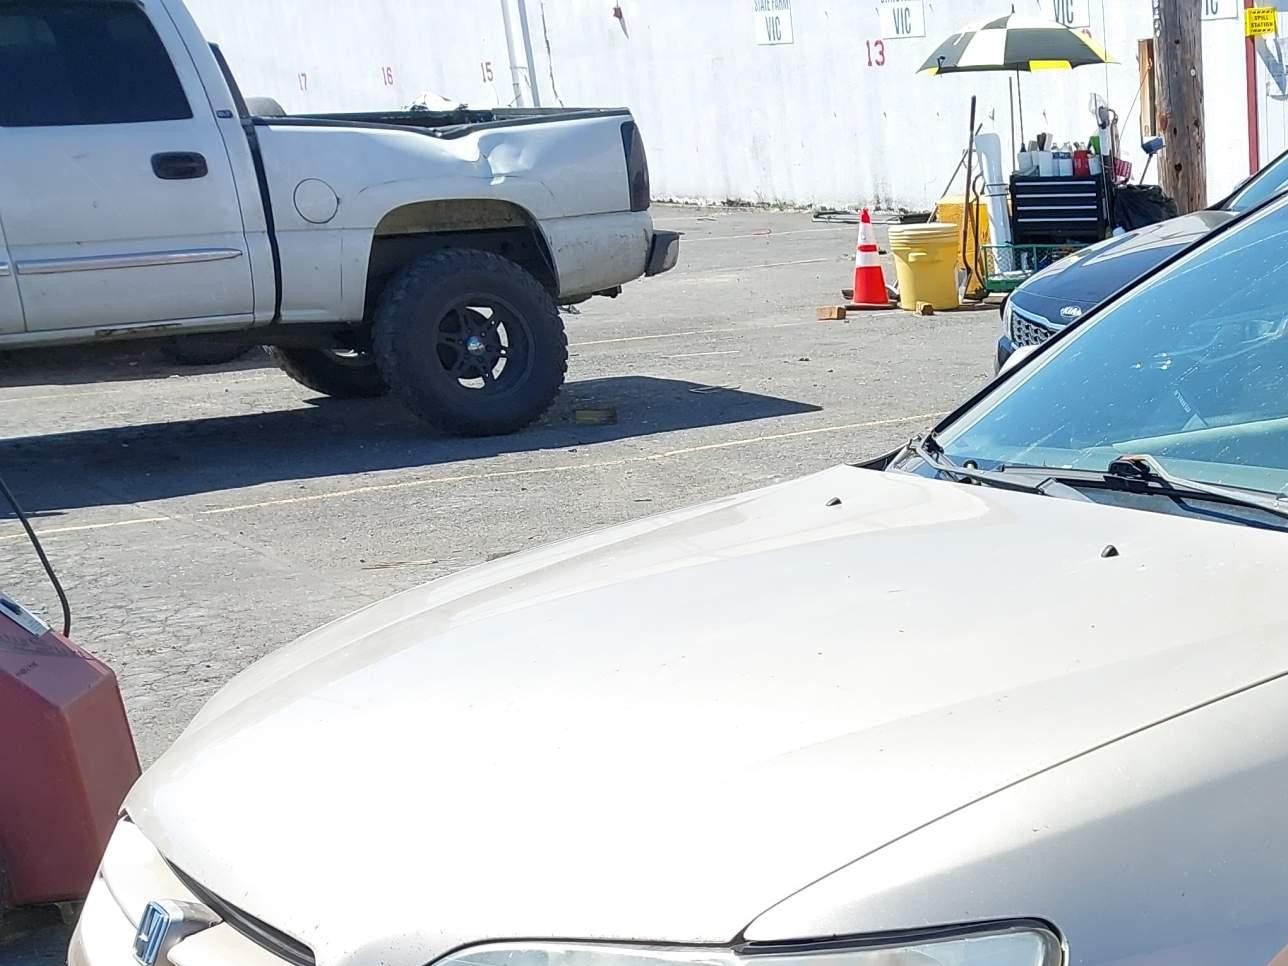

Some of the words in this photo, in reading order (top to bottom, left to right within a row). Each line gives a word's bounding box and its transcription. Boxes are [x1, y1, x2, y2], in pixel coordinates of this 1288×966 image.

[765, 16, 782, 41] VIC
[892, 7, 911, 35] VIC
[866, 40, 886, 66] 13
[298, 73, 308, 90] 17
[382, 67, 394, 86] 16
[481, 62, 495, 83] 15
